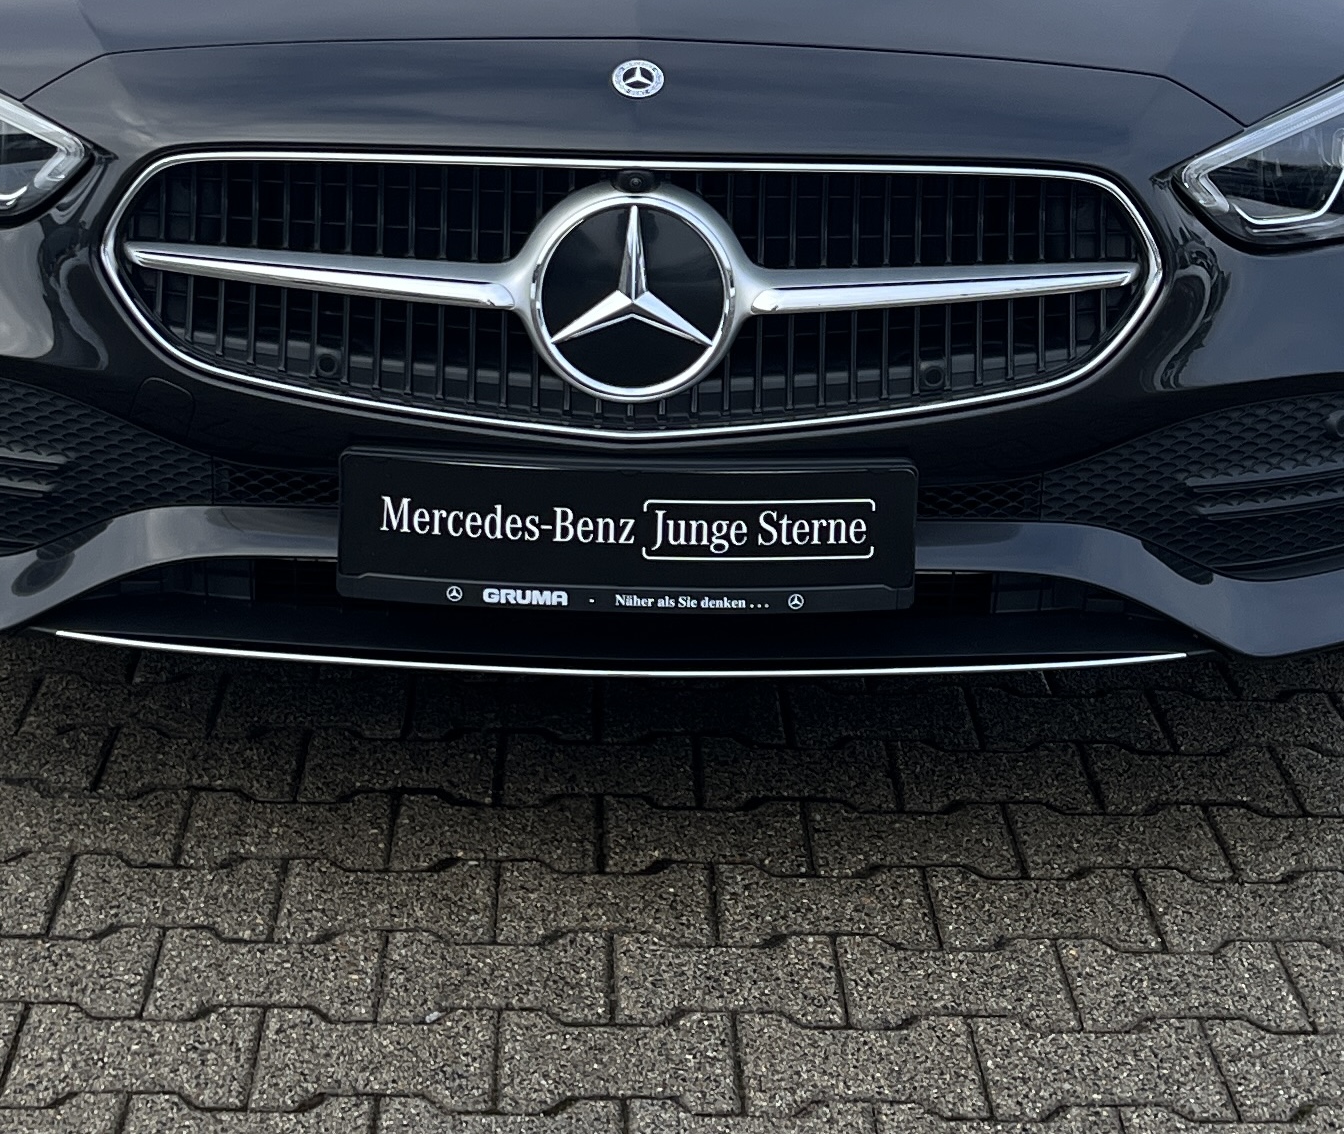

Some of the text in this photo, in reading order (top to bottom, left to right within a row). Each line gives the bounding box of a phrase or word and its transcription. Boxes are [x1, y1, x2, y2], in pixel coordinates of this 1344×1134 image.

[380, 496, 867, 554] Mercedes-Benz Junge Sterne
[482, 588, 568, 606] GRUMA
[615, 594, 654, 608] Näher
[657, 596, 676, 608] als
[677, 596, 698, 609] Sie
[700, 596, 747, 609] denken
